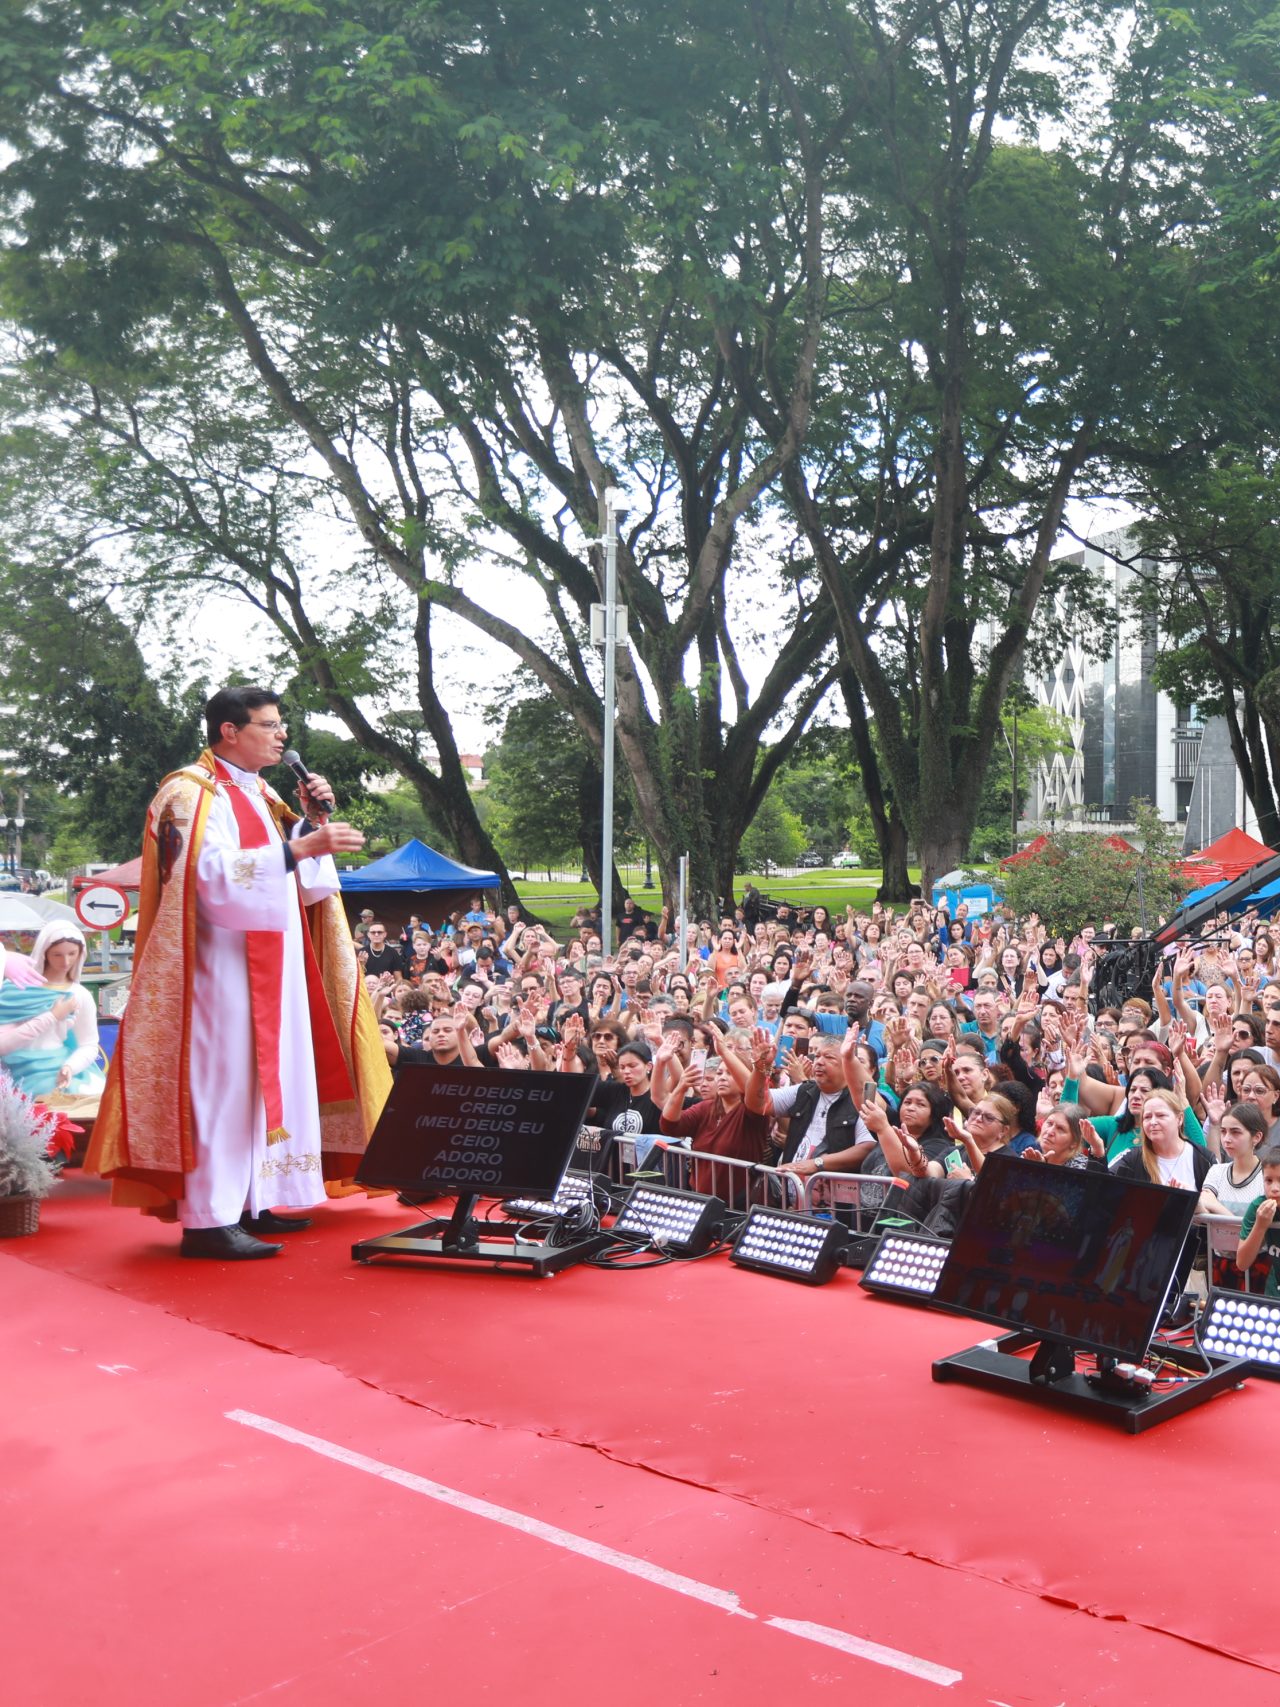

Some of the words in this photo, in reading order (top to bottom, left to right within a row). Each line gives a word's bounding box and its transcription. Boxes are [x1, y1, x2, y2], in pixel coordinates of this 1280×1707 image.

[431, 1083, 472, 1098] MEU
[474, 1086, 524, 1101] DEUS
[528, 1089, 554, 1102] EU
[460, 1101, 517, 1116] CREIO
[415, 1115, 462, 1129] (MEU
[464, 1118, 516, 1133] DEUS
[518, 1121, 545, 1135] EU
[450, 1134, 501, 1150] CEIO)
[434, 1150, 504, 1166] ADORO
[422, 1166, 502, 1184] (ADORO)
